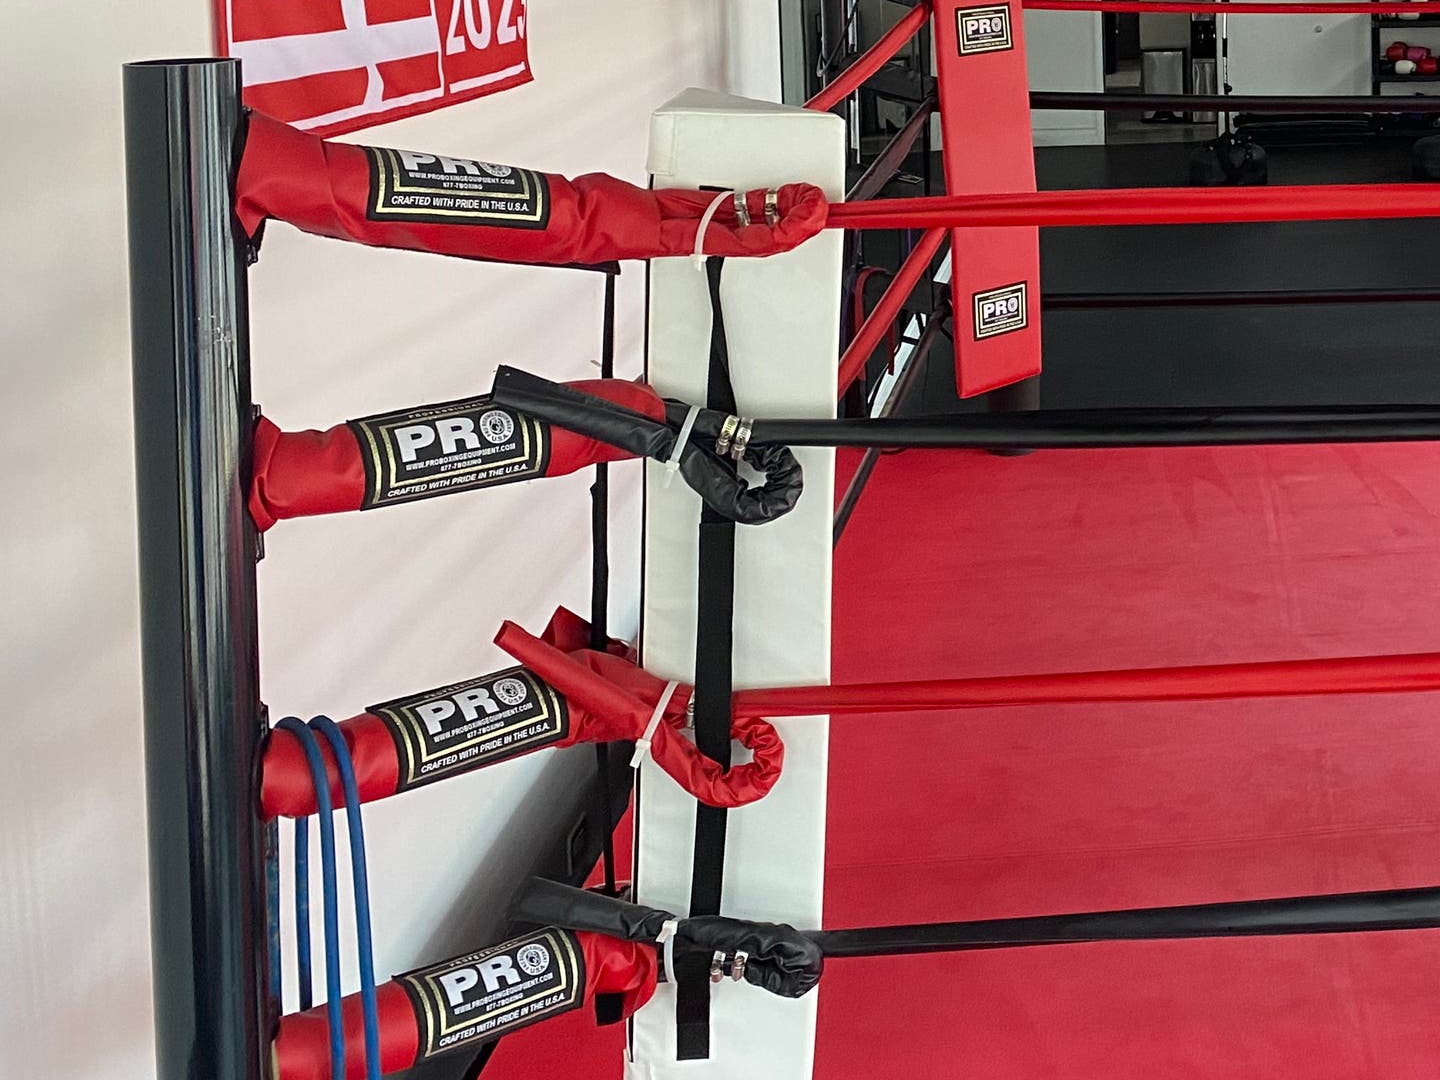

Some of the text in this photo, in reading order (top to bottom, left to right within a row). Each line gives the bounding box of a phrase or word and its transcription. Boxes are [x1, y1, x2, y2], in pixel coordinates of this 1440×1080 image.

[966, 17, 1002, 35] PRO
[391, 195, 530, 212] CRAFTED WITH PRIDE IN THE U.S.A.
[983, 297, 1019, 319] PRO
[394, 410, 514, 463] PRO
[387, 463, 529, 497] CRAFTED WITH PRIDE IN THE U.S.A.
[415, 678, 527, 735] PRO
[421, 722, 551, 773] CRAFTED WITH PRIDE IN THE U.S.A.
[439, 943, 550, 1007] PRO
[439, 992, 566, 1047] CRAFTED WITH PRIDE IN THE U.S.A.
